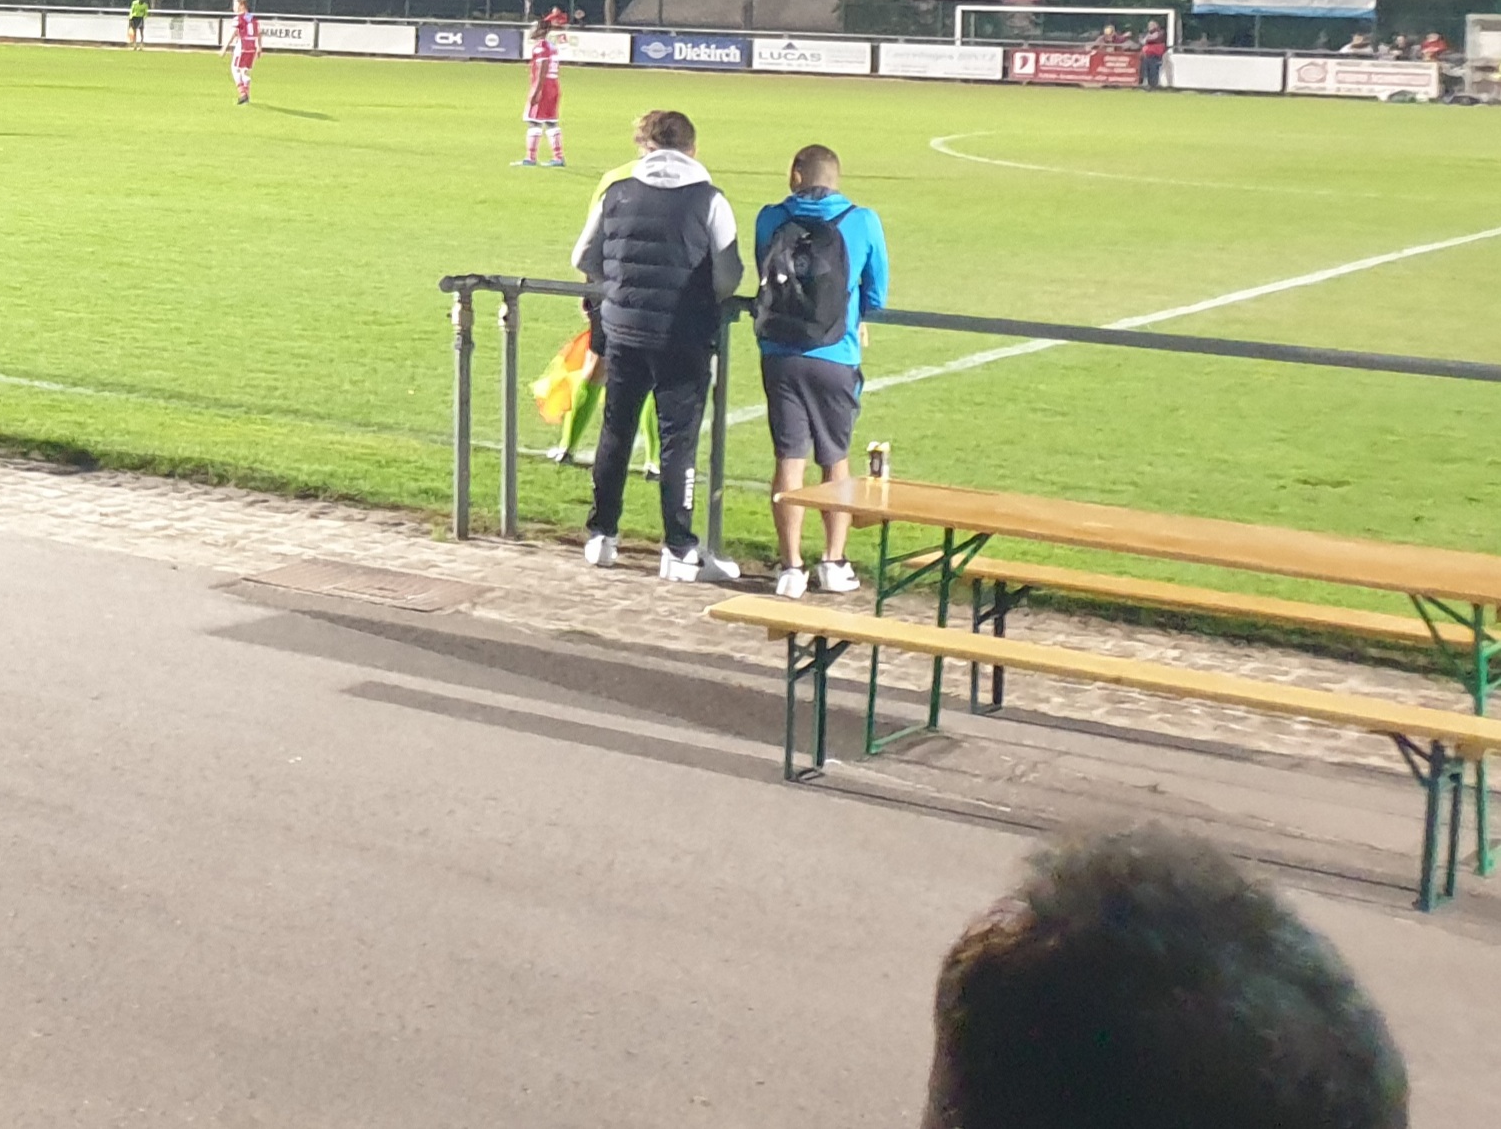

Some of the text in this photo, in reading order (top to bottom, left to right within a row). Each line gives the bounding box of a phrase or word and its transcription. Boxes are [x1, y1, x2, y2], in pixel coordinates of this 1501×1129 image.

[674, 41, 741, 63] Diekirch
[758, 51, 822, 63] LUCAS
[1039, 52, 1091, 68] KIRSCH
